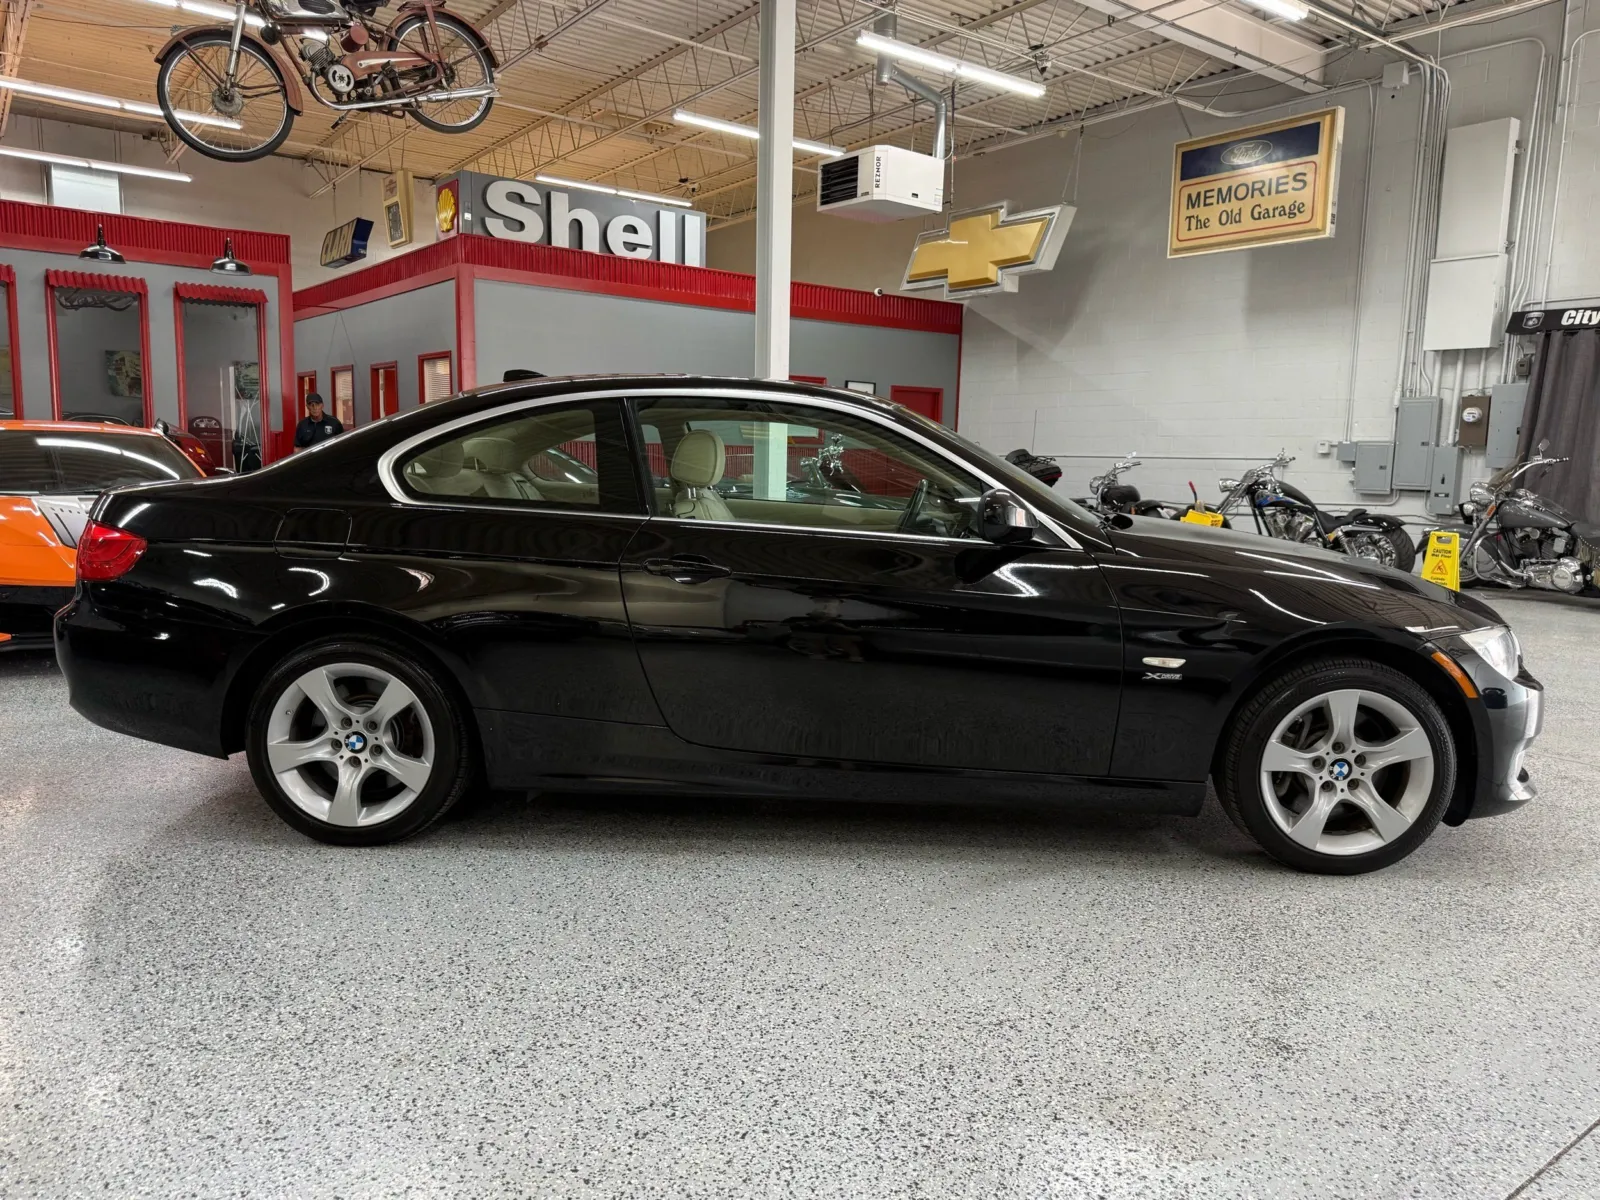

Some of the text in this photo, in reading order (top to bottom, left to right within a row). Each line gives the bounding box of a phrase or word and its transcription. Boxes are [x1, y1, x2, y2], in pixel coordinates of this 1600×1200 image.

[1230, 143, 1262, 163] Ford
[1186, 172, 1308, 210] MEMORIES
[483, 181, 701, 268] Shell
[1185, 199, 1306, 231] The Old Garage
[1561, 309, 1600, 326] City
